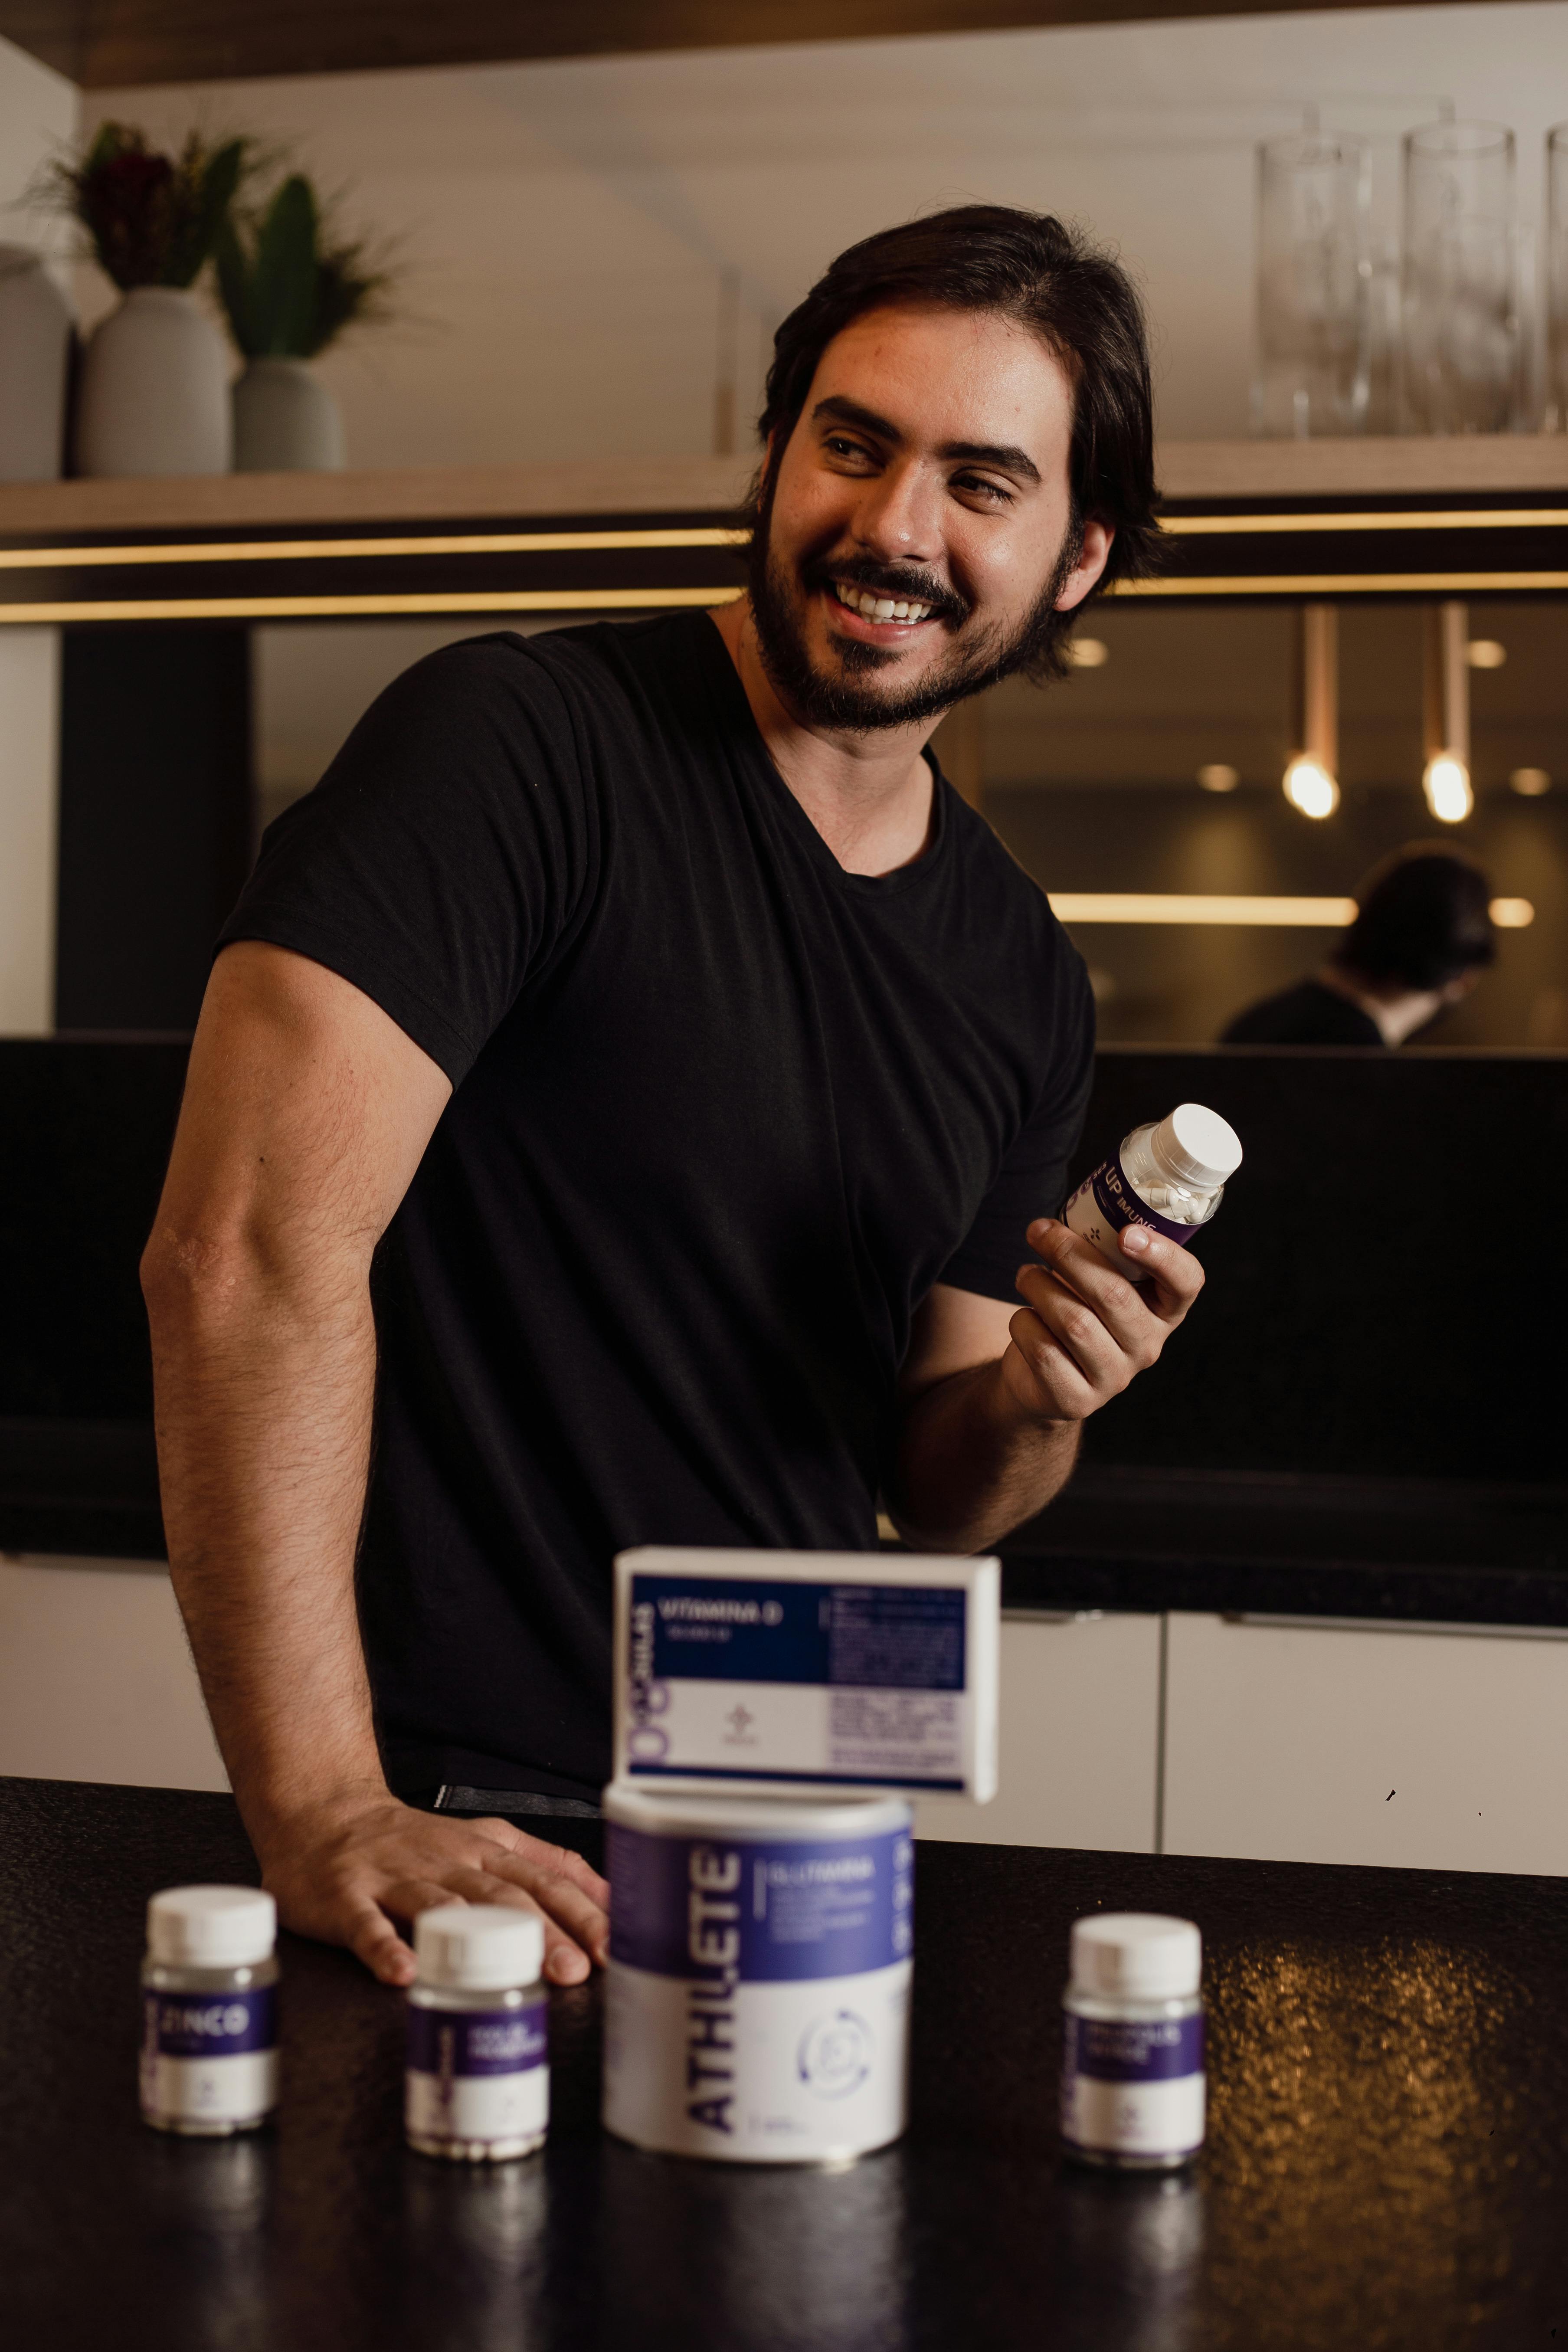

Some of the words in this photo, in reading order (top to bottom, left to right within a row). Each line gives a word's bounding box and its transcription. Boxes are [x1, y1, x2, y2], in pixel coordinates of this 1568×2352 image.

[1106, 1166, 1122, 1194] UP
[657, 1595, 761, 1626] VITAMINA
[762, 1599, 784, 1628] D
[689, 1848, 742, 2136] ATHLETE
[160, 2003, 250, 2038] ZINCO
